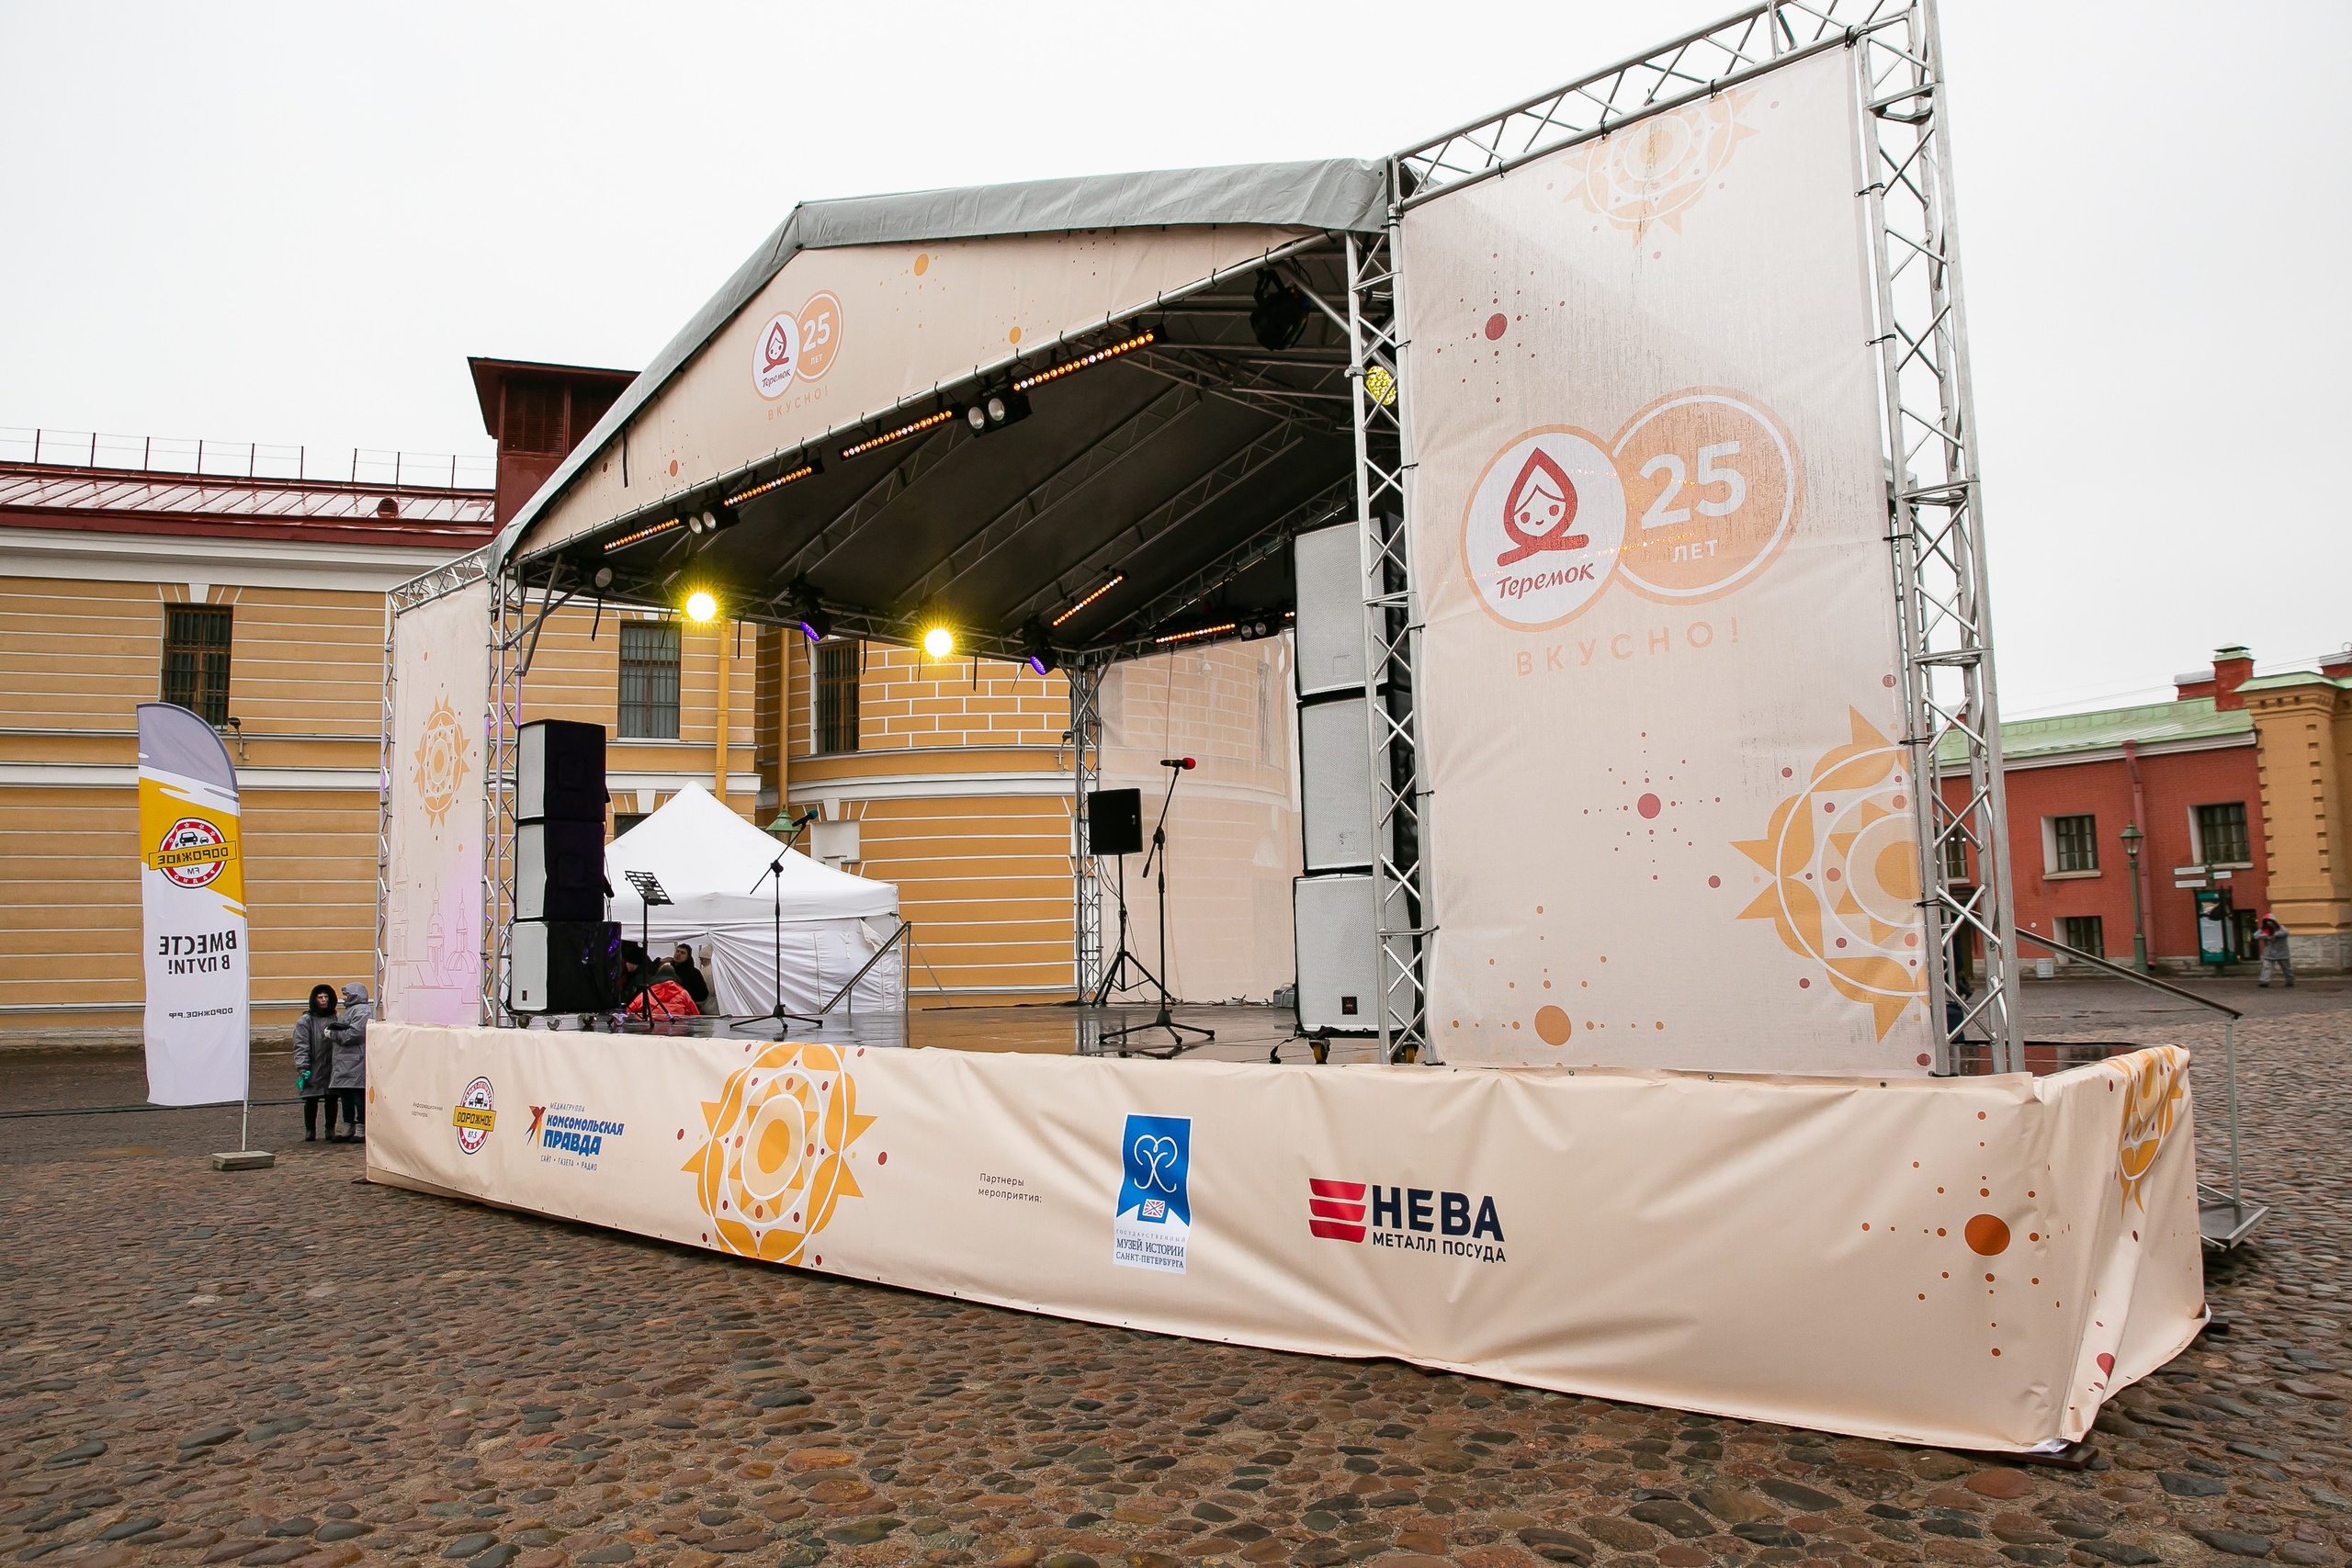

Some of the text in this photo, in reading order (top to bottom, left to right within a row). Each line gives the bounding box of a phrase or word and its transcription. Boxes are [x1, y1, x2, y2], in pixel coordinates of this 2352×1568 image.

[802, 311, 831, 353] 25
[809, 354, 823, 366] ЛЕТ
[762, 368, 791, 388] Теремок
[768, 385, 829, 421] ВКУСНО!
[1639, 440, 1747, 531] 25
[1672, 539, 1720, 563] ЛЕТ
[1495, 561, 1595, 600] Теремок
[1516, 616, 1740, 677] ВКУСНО!
[546, 1114, 625, 1135] КОМСОМОЛЬСКАЯ
[543, 1129, 603, 1156] ПРАВДА
[540, 1154, 598, 1171] САЙТ ГАЗЕТА РАДИО
[979, 1172, 1024, 1187] Партнеры
[978, 1188, 1042, 1202] мероприятия:
[1372, 1184, 1505, 1242] НЕВА
[1115, 1229, 1186, 1243] ГОСУДАРСТВЕННЫЙ
[1116, 1238, 1184, 1258] МУЗЕЙ ИСТОРИИ
[1373, 1232, 1507, 1263] МЕТАЛЛ ПОСУДА
[1115, 1251, 1184, 1269] САНКТ-ПЕТЕРБУРГА
